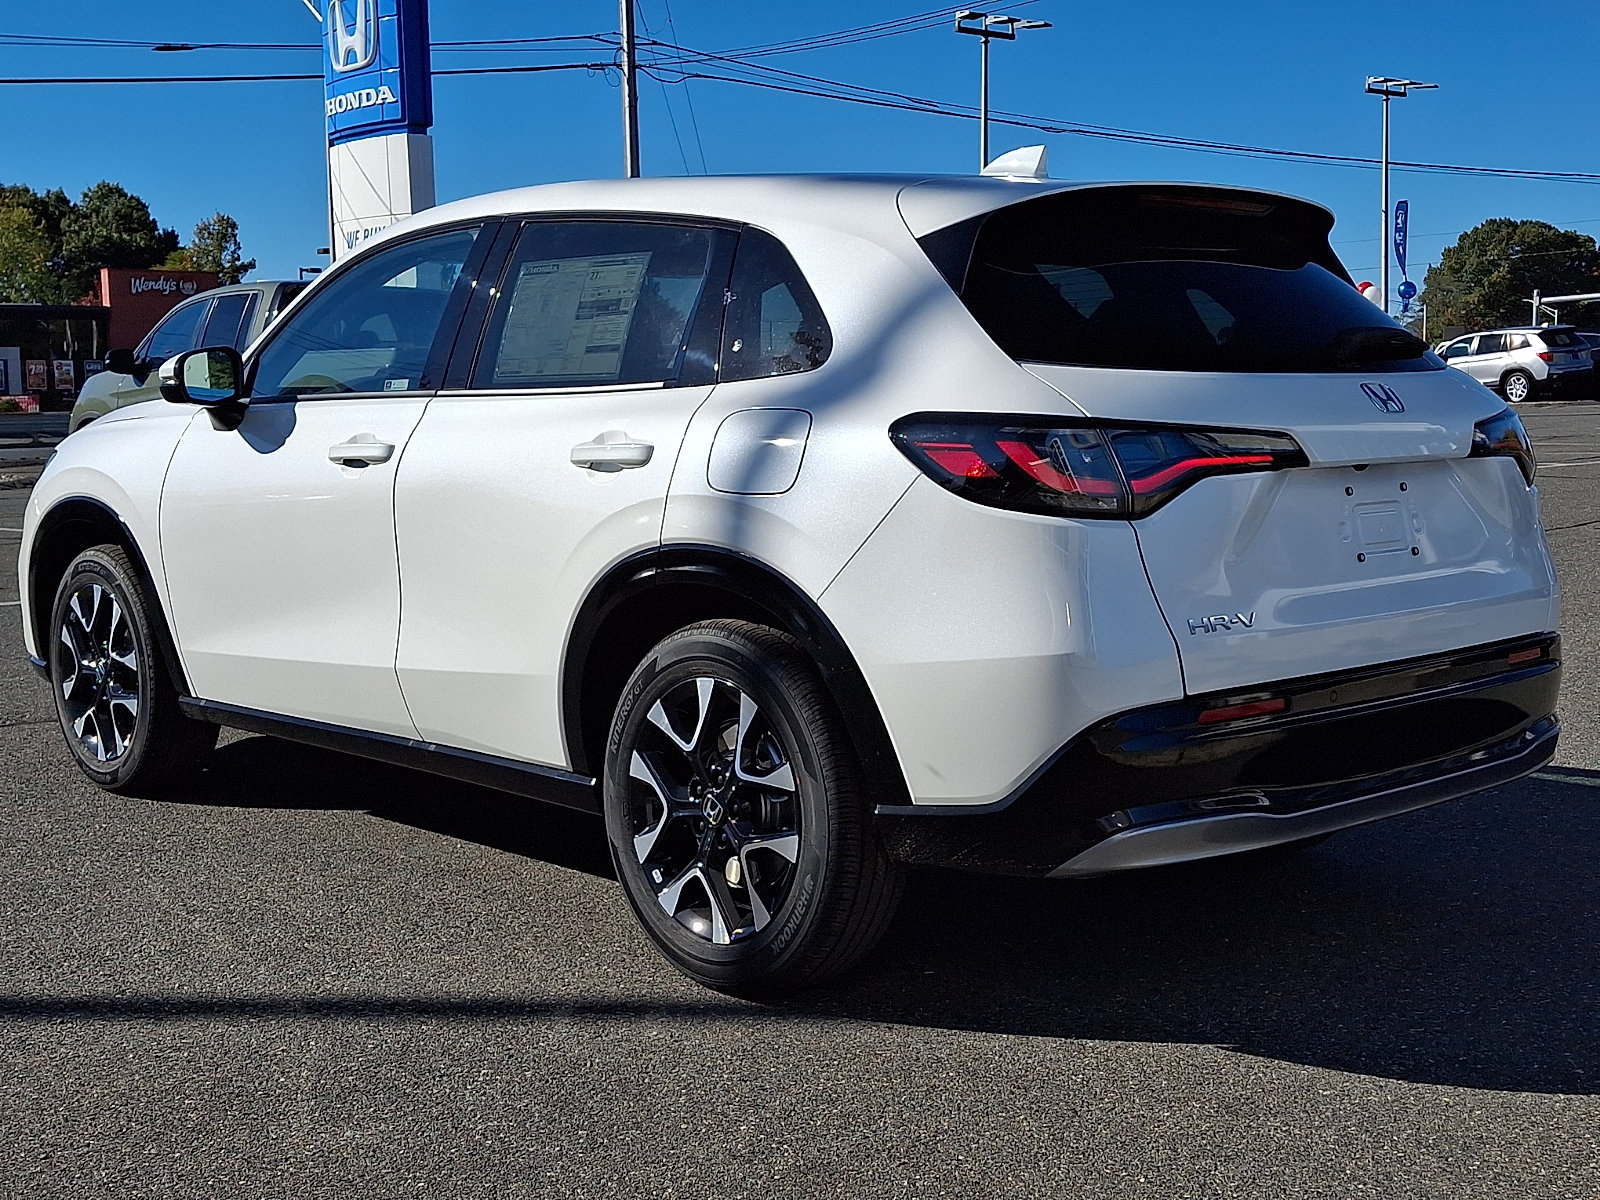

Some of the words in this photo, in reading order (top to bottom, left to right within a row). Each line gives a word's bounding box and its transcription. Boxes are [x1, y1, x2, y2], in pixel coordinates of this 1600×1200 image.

[326, 85, 398, 116] HONDA
[131, 275, 177, 295] Wendy's
[1187, 611, 1256, 635] HR-V
